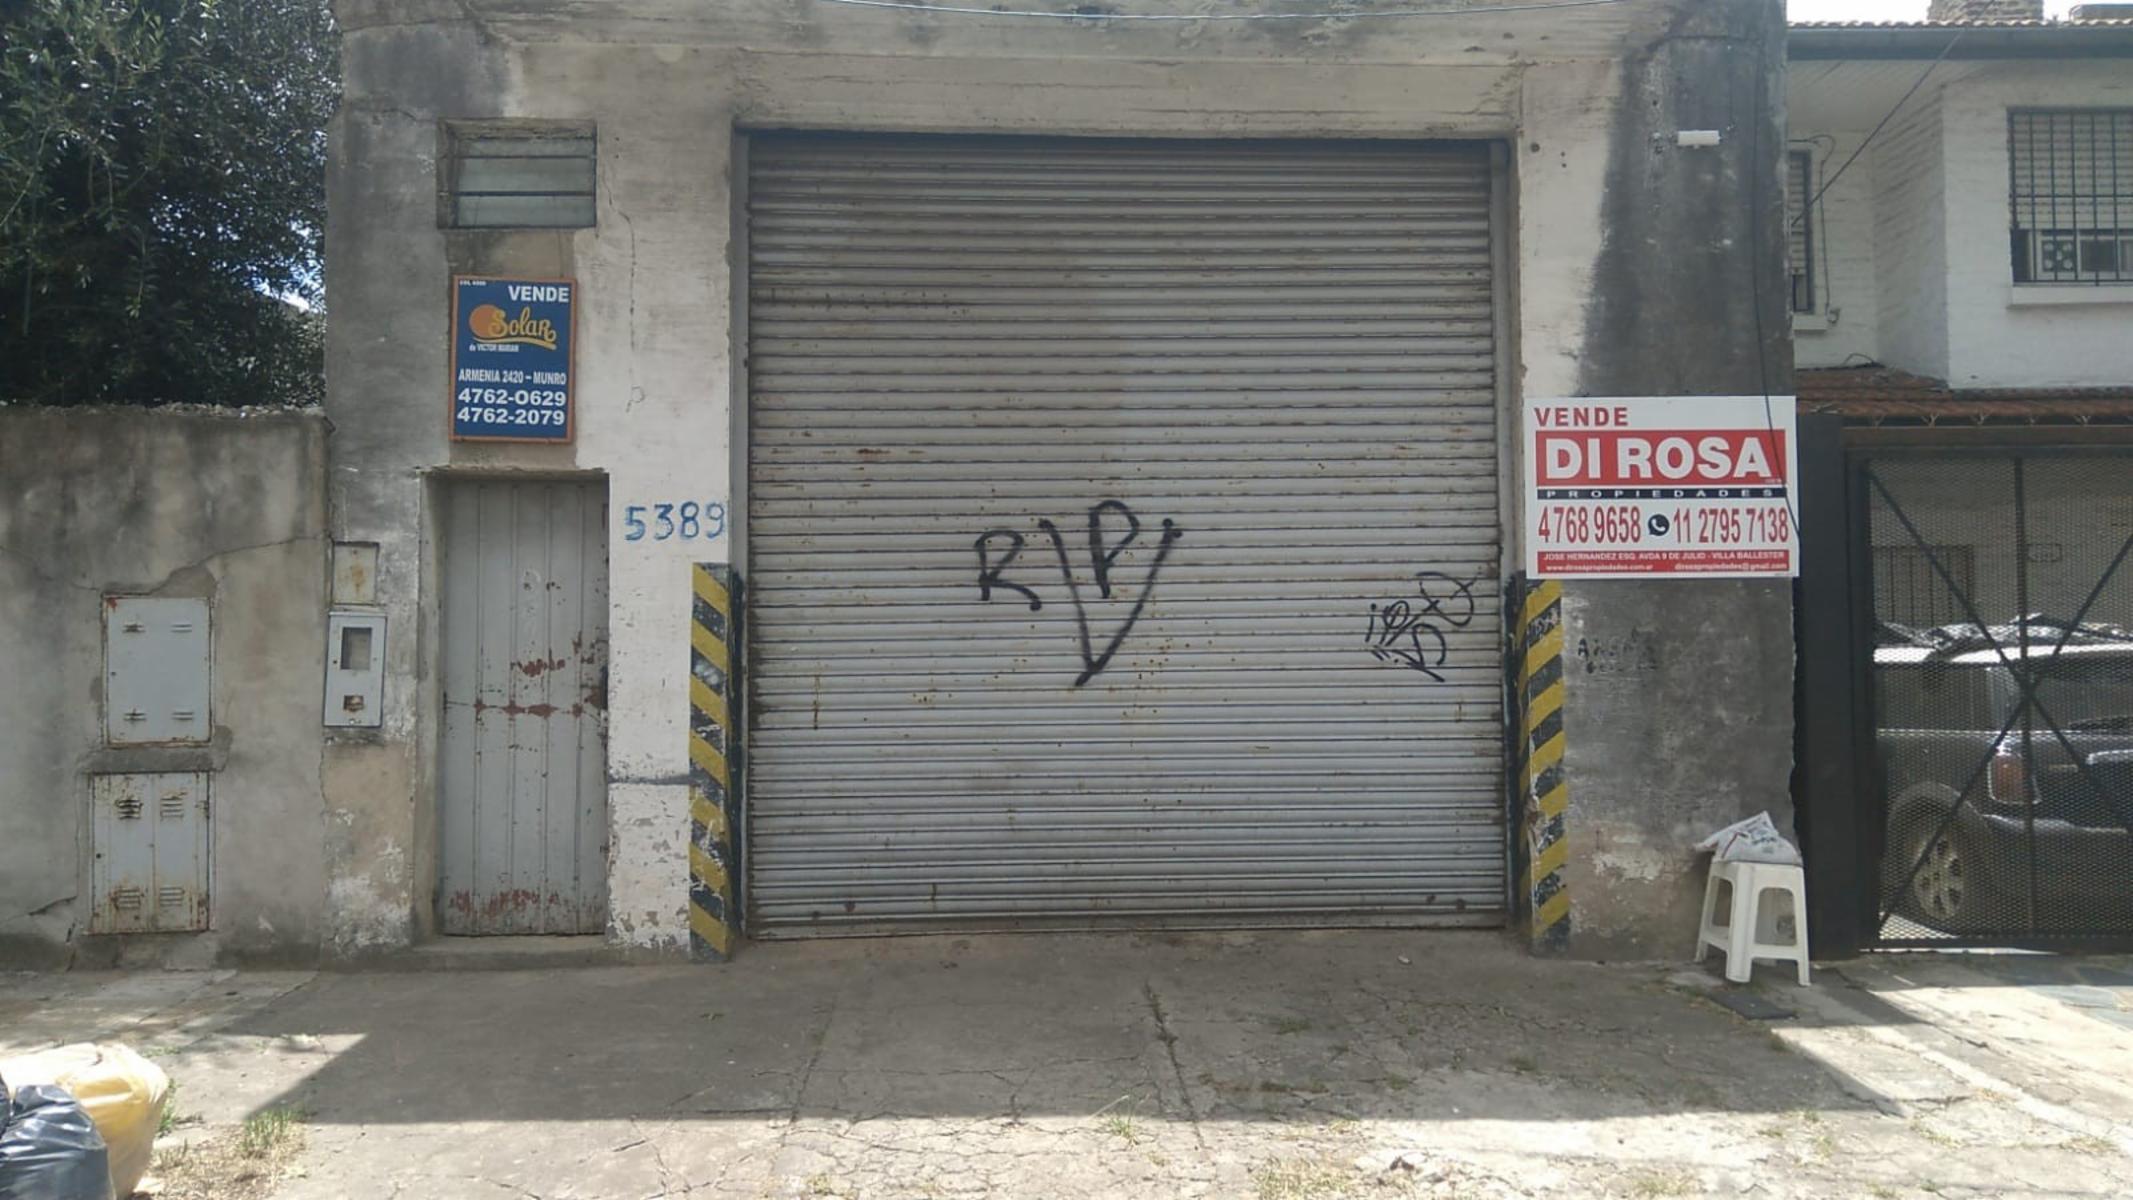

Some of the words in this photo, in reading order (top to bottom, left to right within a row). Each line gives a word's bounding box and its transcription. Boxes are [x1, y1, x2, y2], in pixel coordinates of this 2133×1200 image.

[508, 285, 569, 302] VENDE
[458, 368, 500, 382] ARMENIA
[502, 370, 524, 383] 2420
[533, 371, 567, 385] MUNRO
[457, 407, 565, 425] 4762-2079
[1534, 407, 1628, 427] VENDE
[1545, 437, 1601, 479] DI
[1616, 436, 1772, 479] ROSA
[1546, 489, 1773, 498] PROPIEDADES
[624, 500, 726, 541] 5389
[1538, 506, 1589, 543] 4768
[1594, 506, 1641, 543] 9658
[1673, 507, 1692, 543] 11
[1698, 507, 1741, 543] 2795
[1746, 507, 1789, 543] 7138
[1544, 553, 1565, 561] JOSE
[1567, 552, 1617, 561] HERNANDEZ
[1662, 552, 1667, 560] 9
[1668, 552, 1679, 560] DE
[1682, 552, 1706, 560] JULIO
[1711, 552, 1736, 560] VILLA
[1737, 551, 1785, 560] BALLESTER
